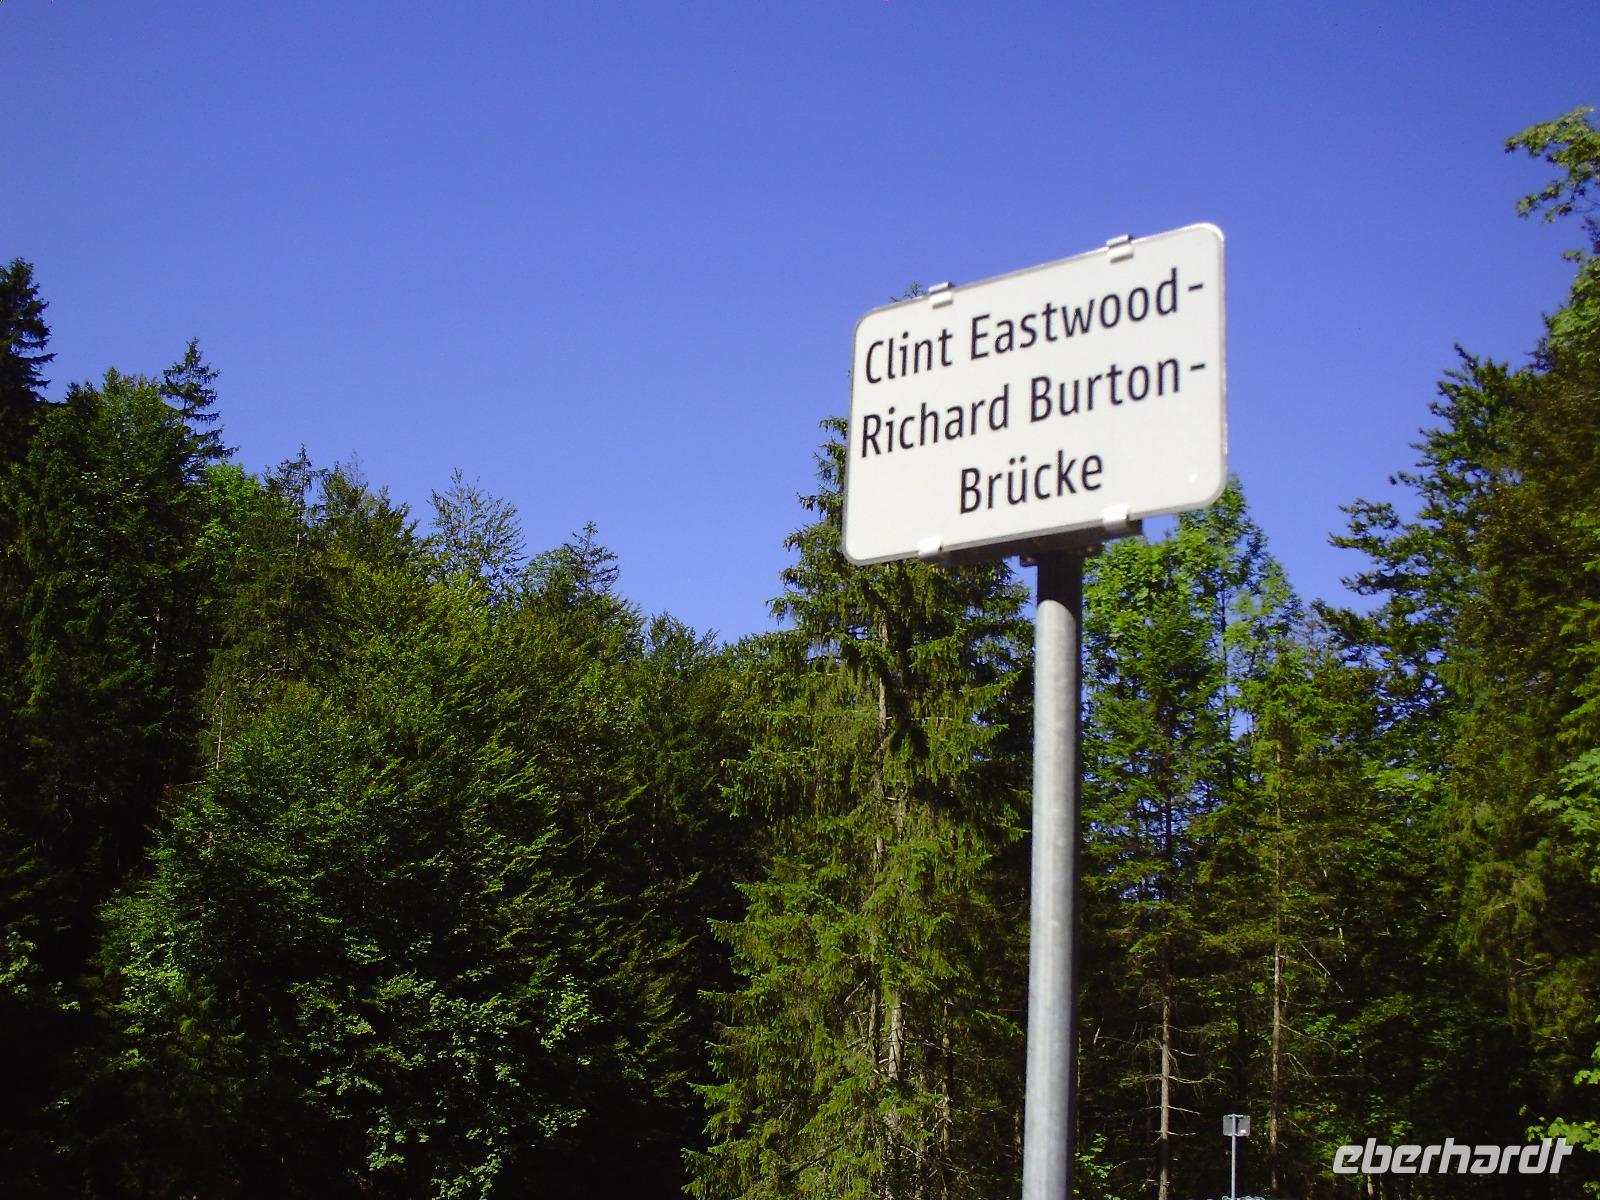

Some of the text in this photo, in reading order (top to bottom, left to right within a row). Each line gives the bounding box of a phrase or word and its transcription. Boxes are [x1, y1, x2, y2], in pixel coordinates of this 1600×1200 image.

[865, 267, 1204, 384] Clint Eastwood-
[861, 357, 1206, 459] Richard Burton-
[960, 449, 1103, 515] Brücke
